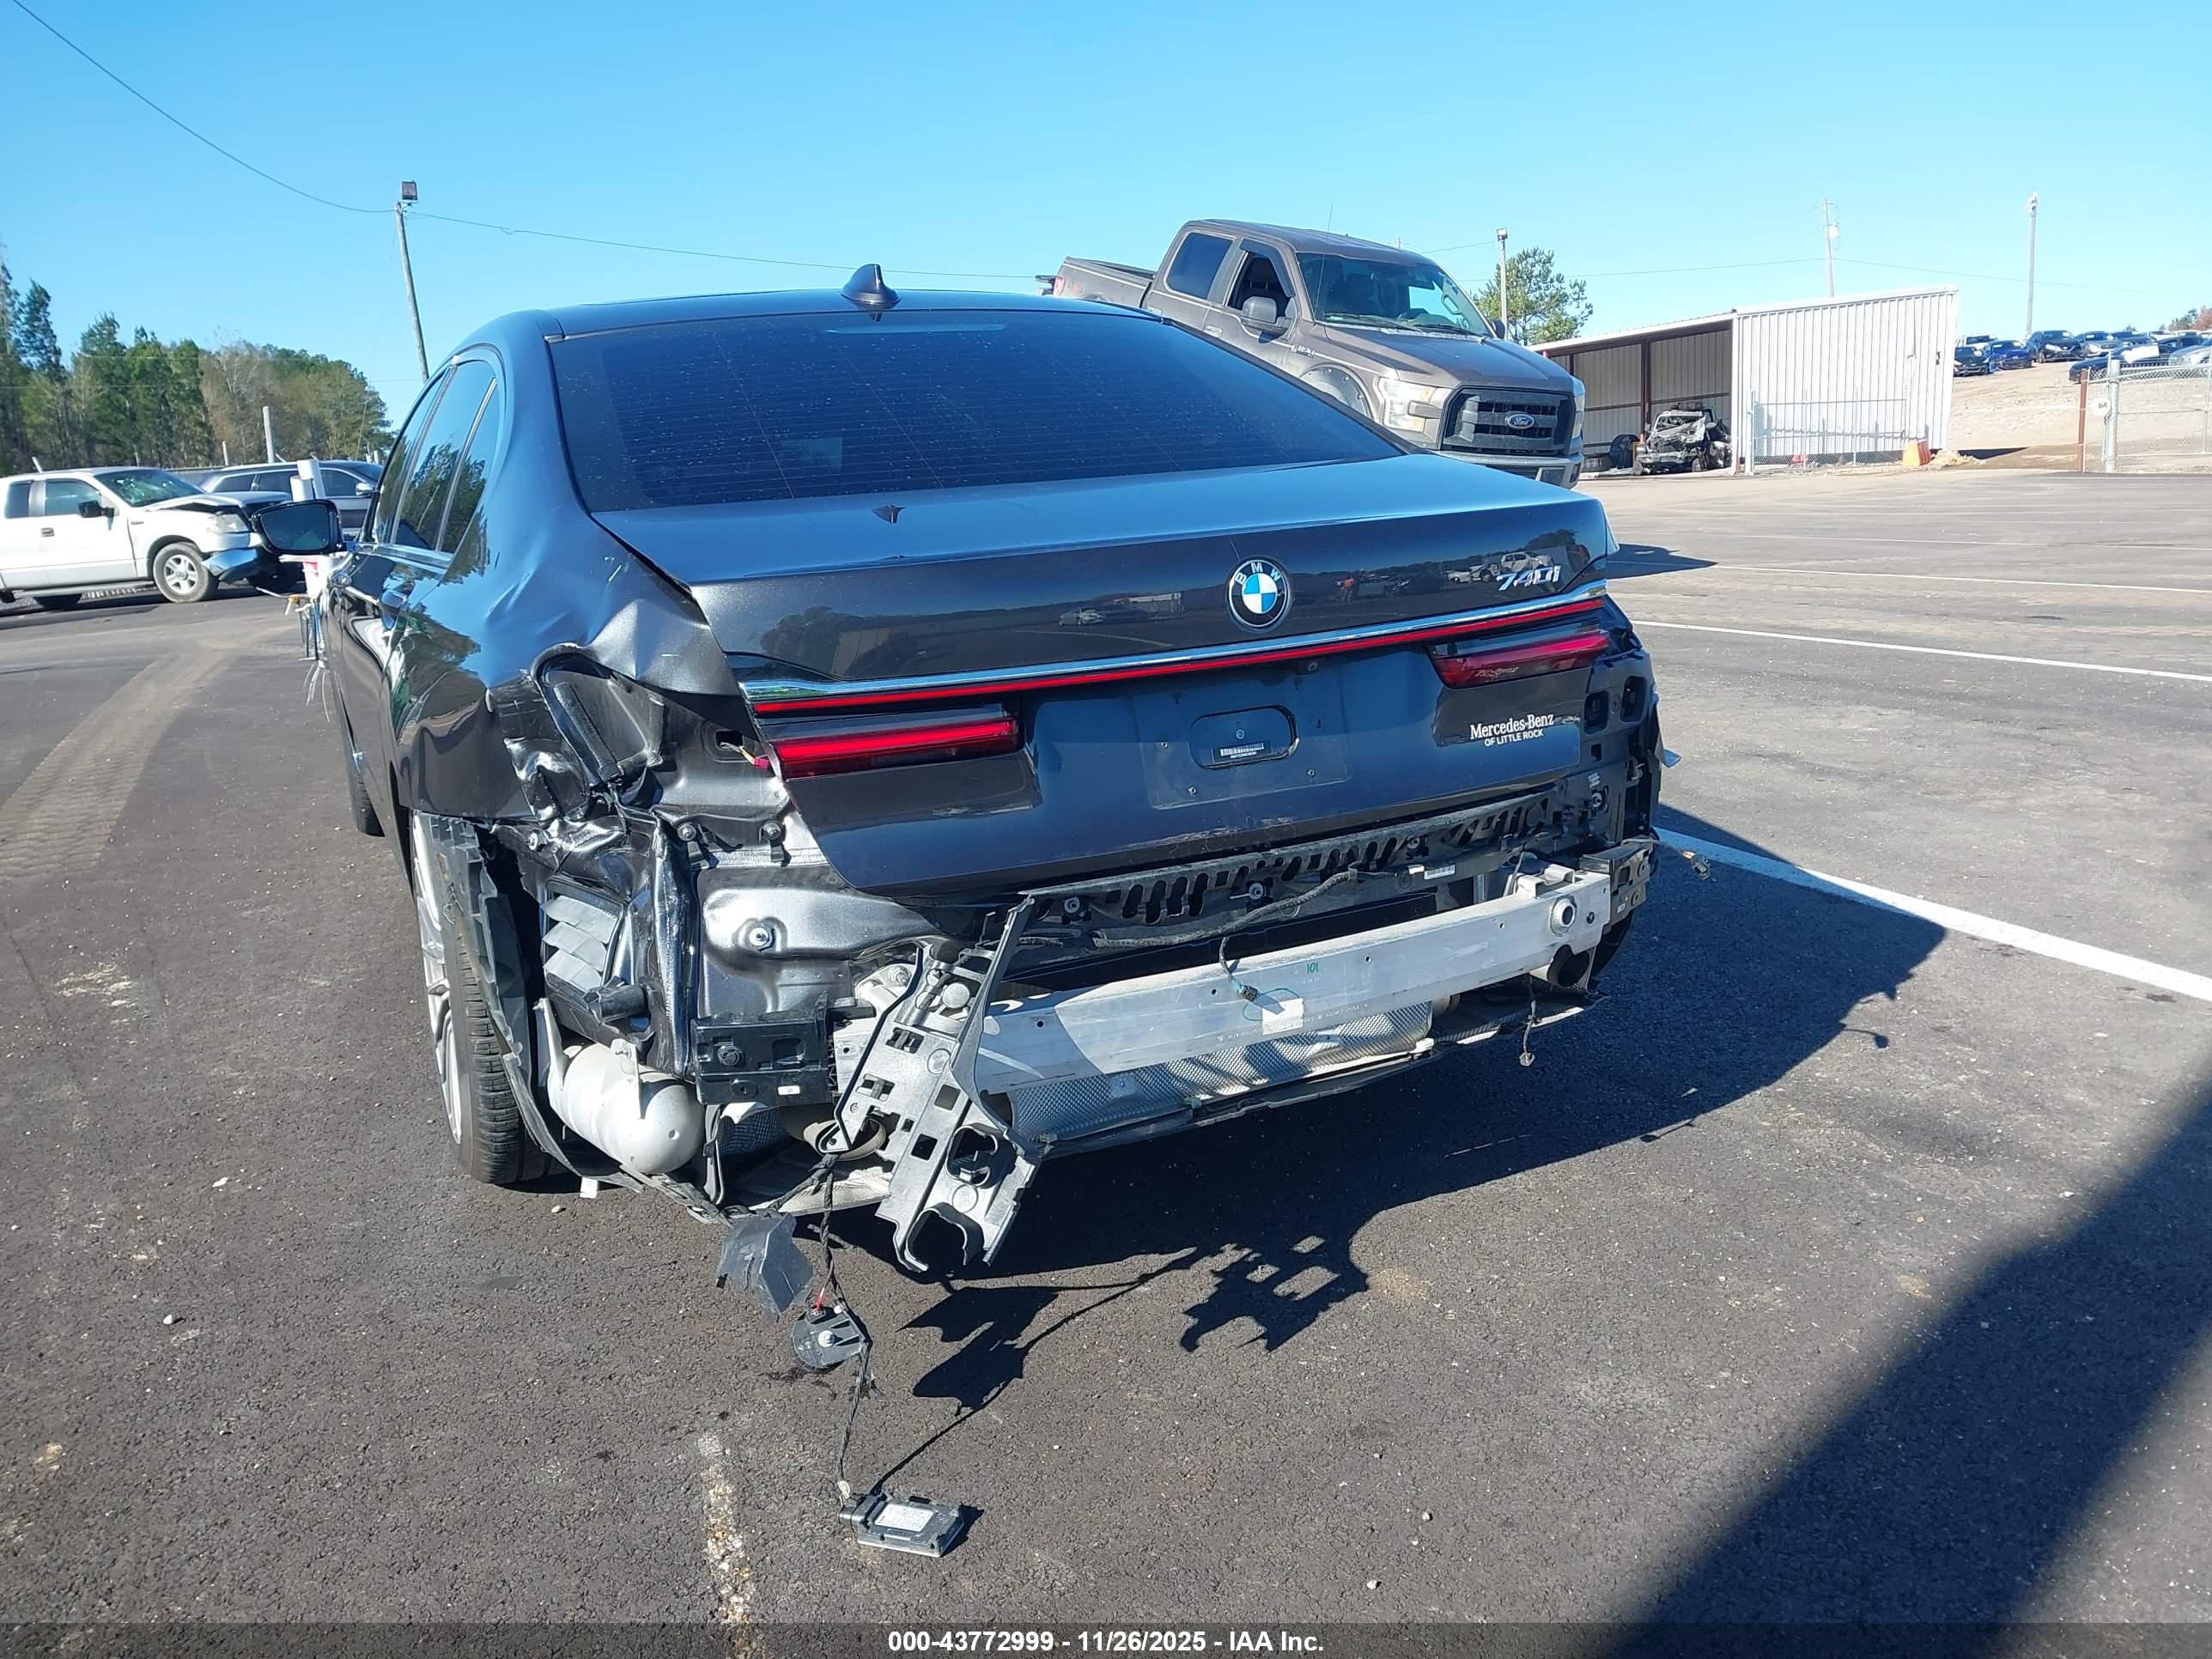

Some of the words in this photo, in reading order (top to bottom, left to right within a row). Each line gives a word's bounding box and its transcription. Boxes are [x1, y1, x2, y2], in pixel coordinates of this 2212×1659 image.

[1235, 562, 1280, 585] BMW
[1470, 714, 1554, 740] Mercedes-Benz
[1484, 738, 1496, 747] OF
[1497, 732, 1522, 745] LITTLE
[1522, 728, 1544, 740] ROCK
